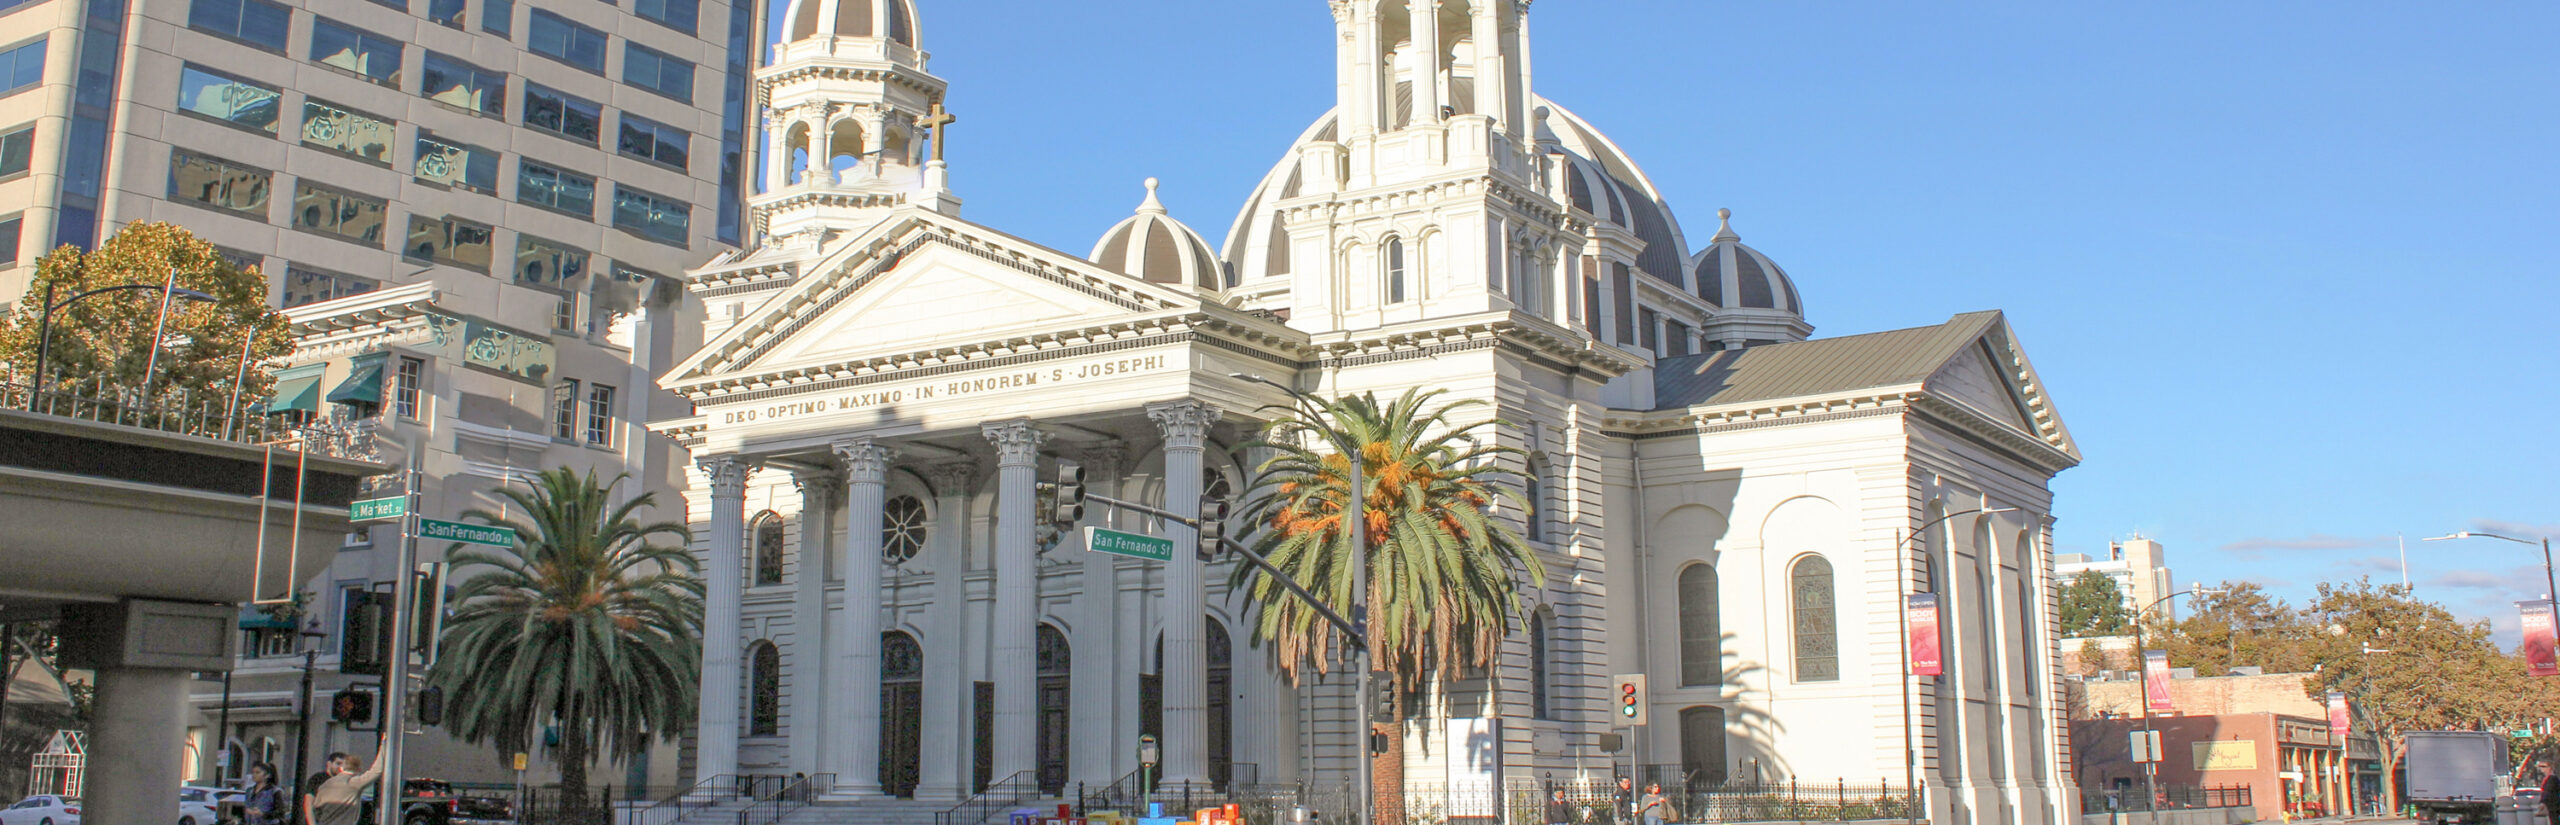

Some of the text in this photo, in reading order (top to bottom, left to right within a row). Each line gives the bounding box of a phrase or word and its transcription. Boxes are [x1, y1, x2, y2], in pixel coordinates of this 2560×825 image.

[725, 355, 1165, 424] DEO OPTIMO MAXIMO IN HONOREM S JOSEPHI
[1094, 534, 1170, 556] San Fernando St
